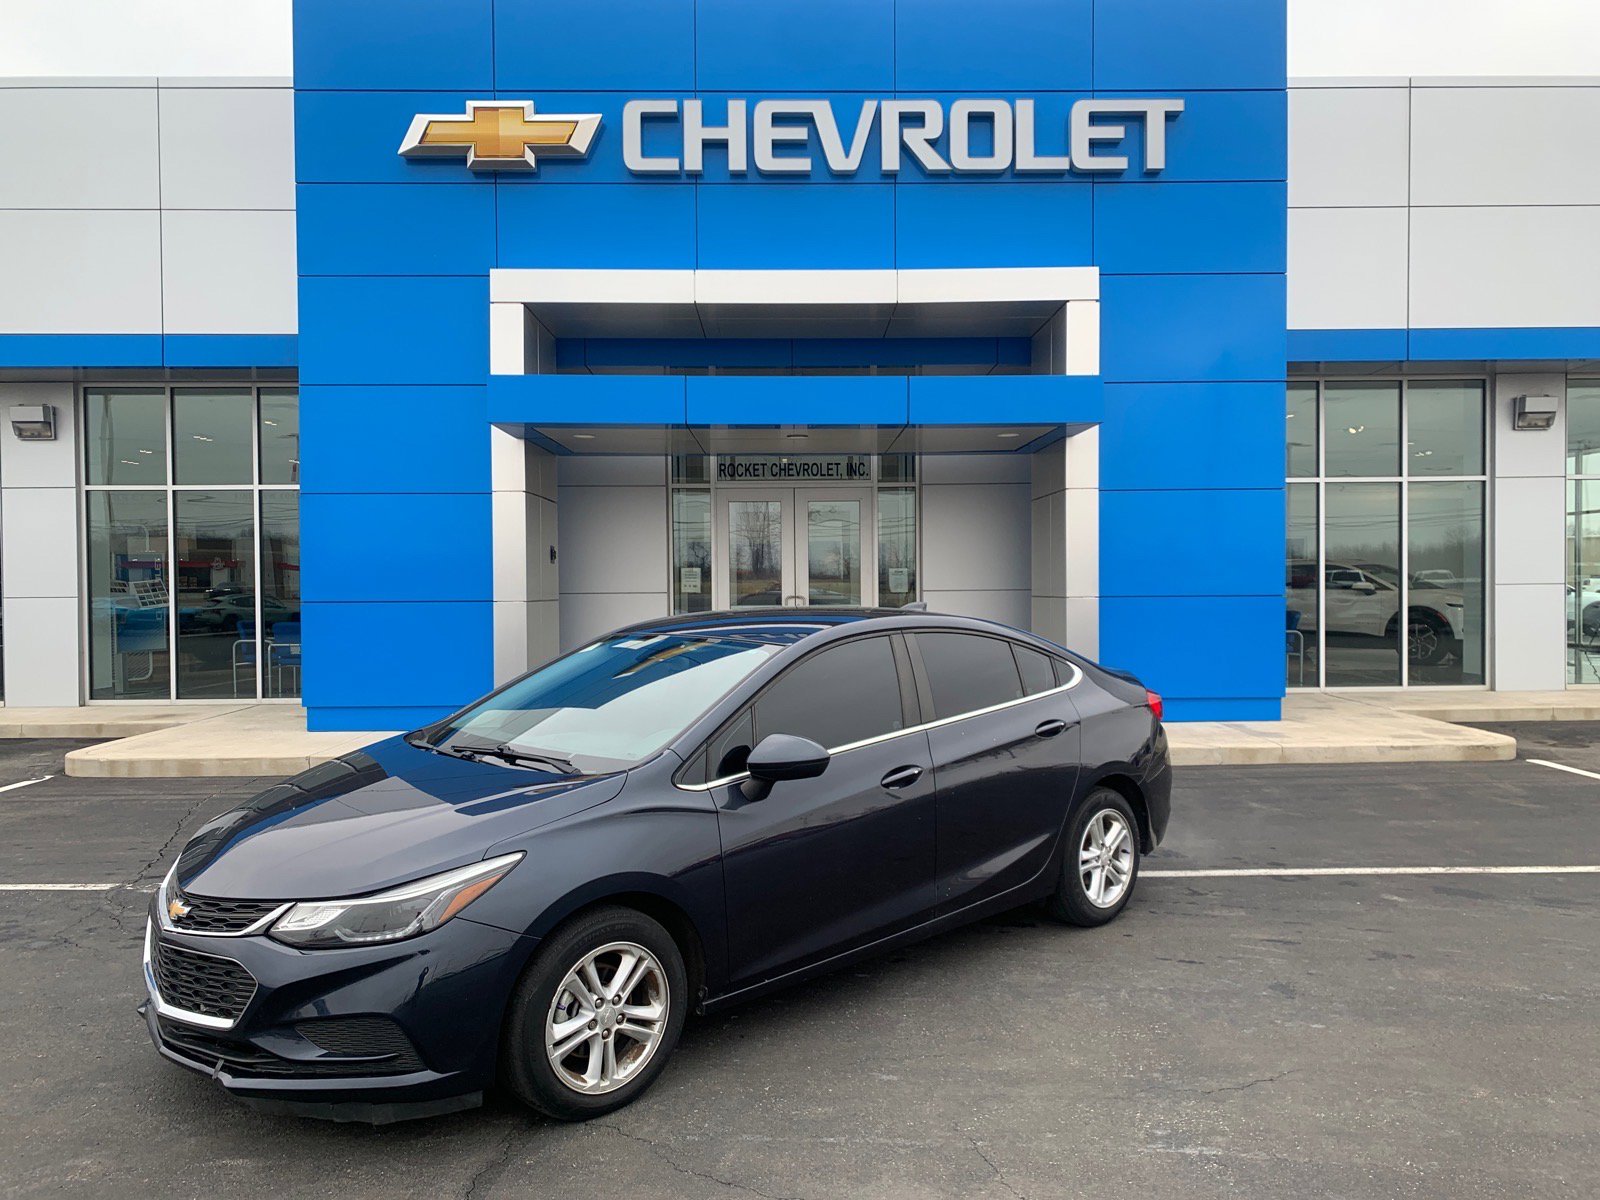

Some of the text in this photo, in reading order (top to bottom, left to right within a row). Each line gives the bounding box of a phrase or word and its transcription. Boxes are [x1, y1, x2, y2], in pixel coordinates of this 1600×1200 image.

[622, 98, 1185, 173] CHEVROLET
[718, 461, 869, 479] ROCKET CHEVROLET, INC.
